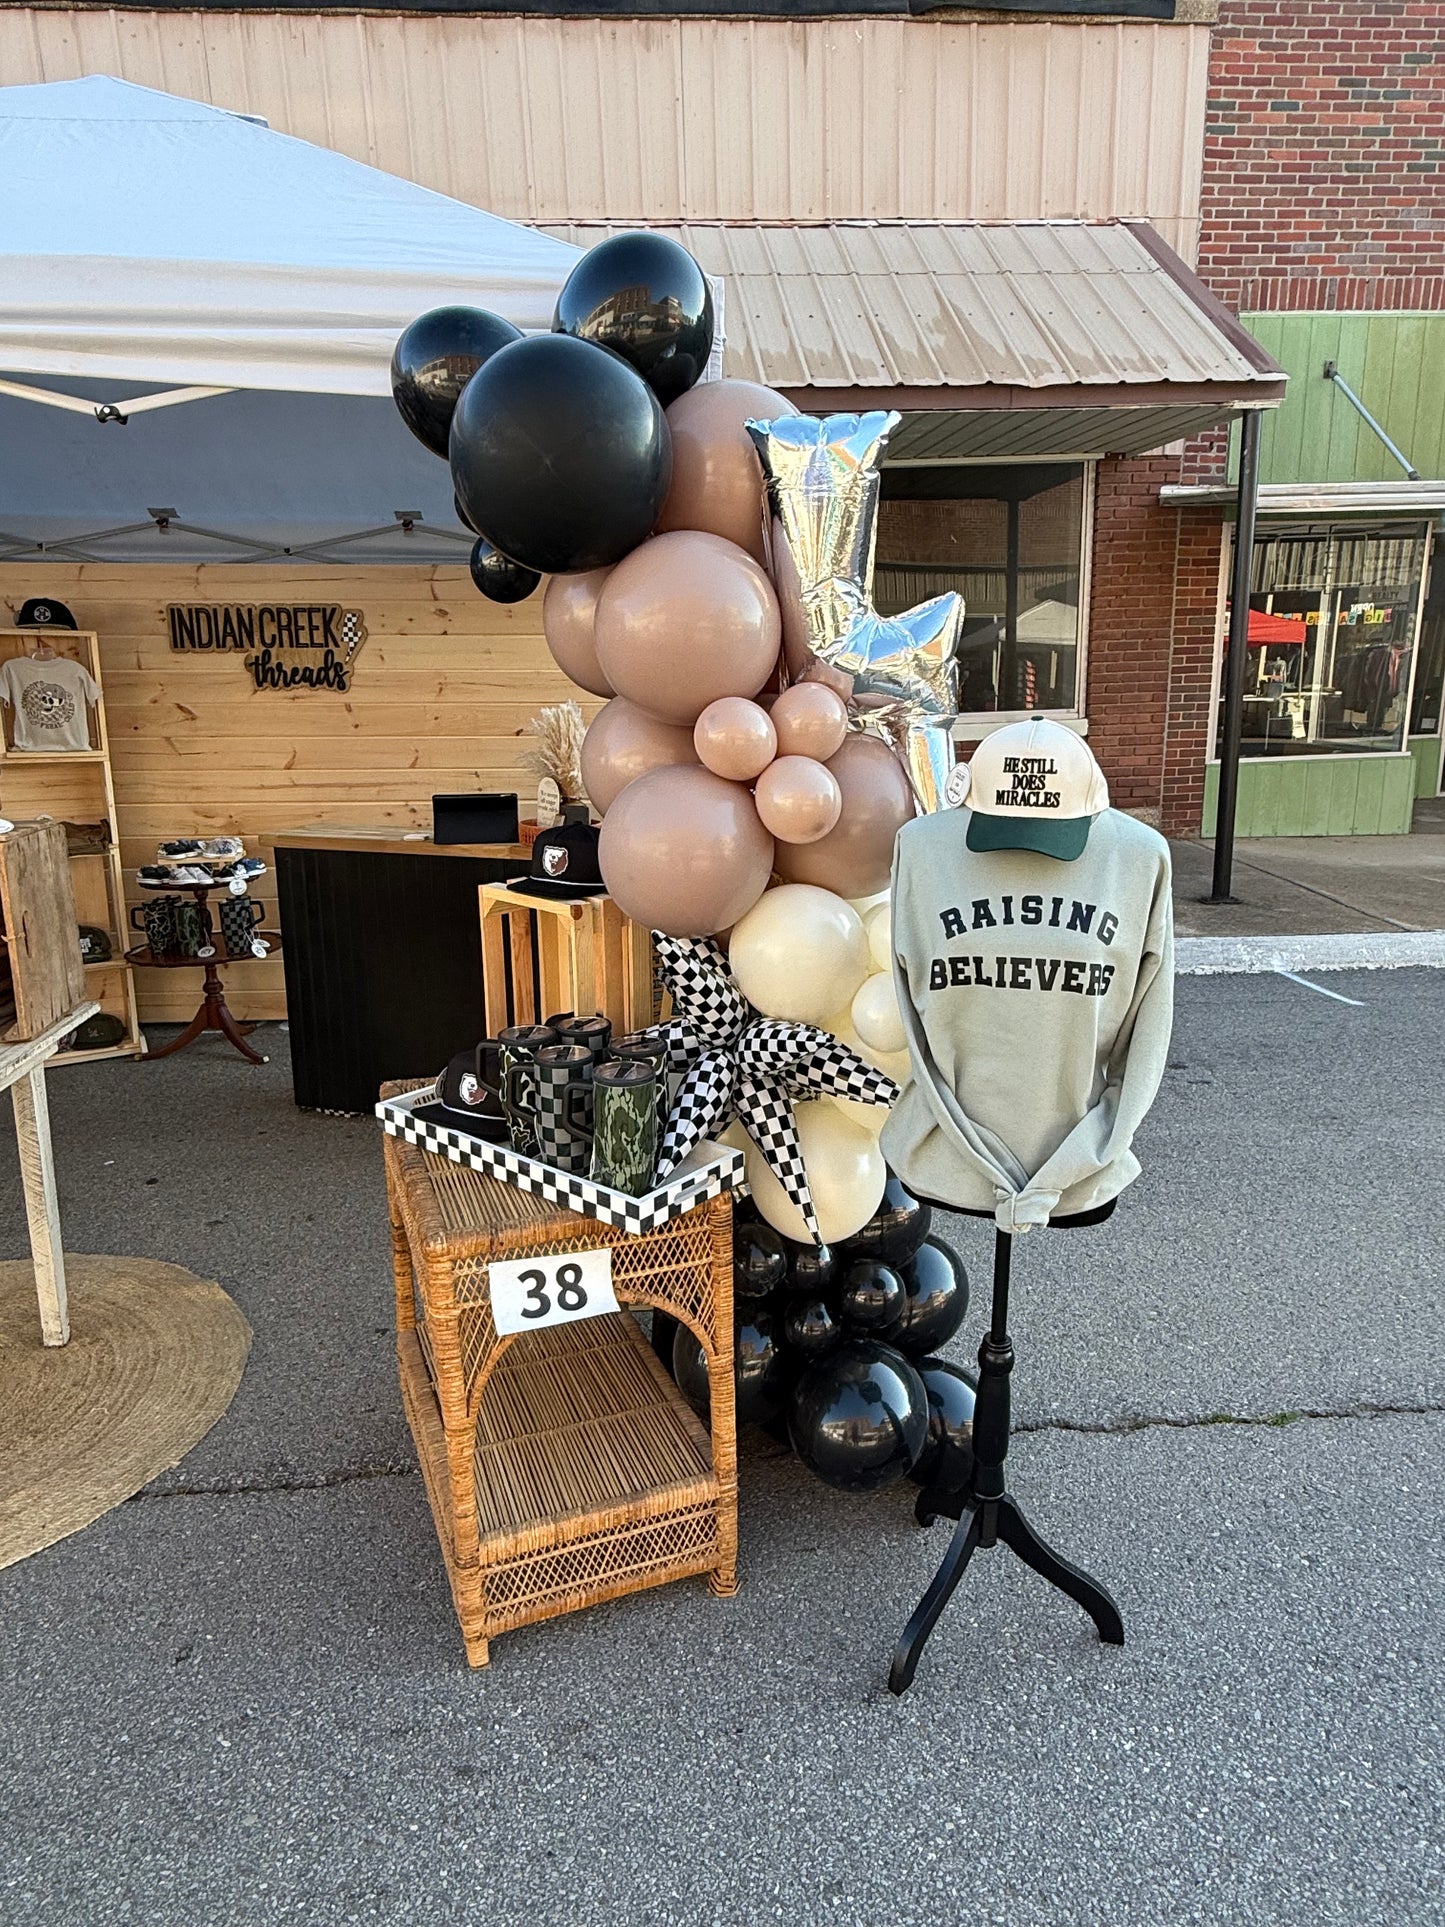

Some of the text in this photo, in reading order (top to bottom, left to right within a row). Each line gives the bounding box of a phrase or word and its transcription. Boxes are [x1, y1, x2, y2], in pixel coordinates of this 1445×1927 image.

[169, 607, 341, 649] INDIAN CREEK
[248, 648, 350, 691] threads
[1003, 757, 1058, 775] HE STILL
[1011, 774, 1046, 790] DOES
[995, 789, 1061, 808] MIRACLES
[939, 895, 1120, 947] RAISING
[929, 956, 1116, 997] BELIEVERS
[517, 1262, 588, 1319] 38
